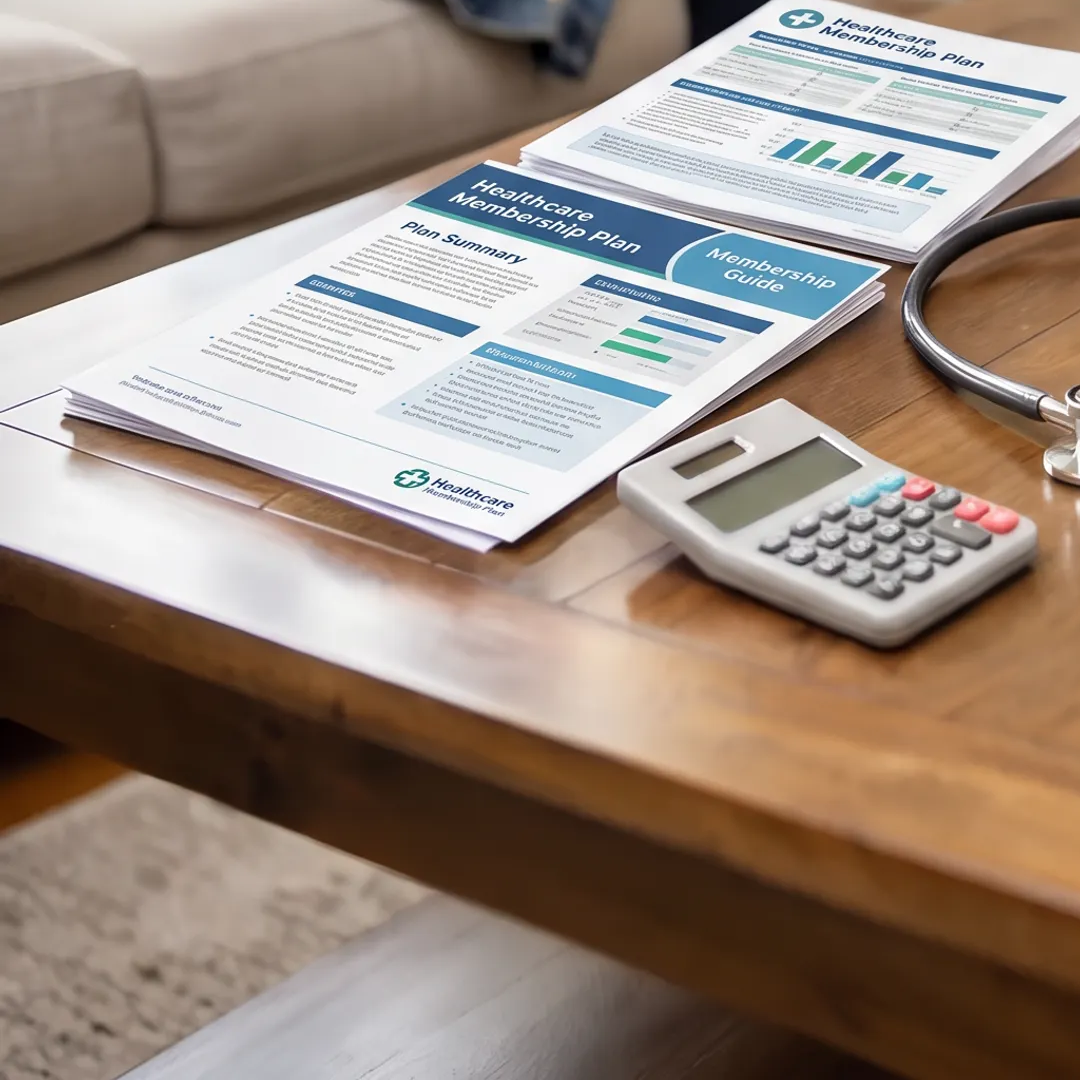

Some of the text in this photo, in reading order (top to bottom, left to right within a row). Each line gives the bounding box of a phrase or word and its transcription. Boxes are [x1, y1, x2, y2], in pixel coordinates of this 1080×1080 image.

[819, 25, 938, 59] Membership
[940, 52, 985, 69] Plan
[832, 17, 937, 47] Healthcare
[471, 179, 594, 222] Healthcare
[400, 221, 528, 265] Plan Summary
[449, 191, 642, 254] Membership Plan
[705, 247, 837, 289] Membership
[723, 269, 784, 293] Guide
[431, 478, 514, 510] Healthcare
